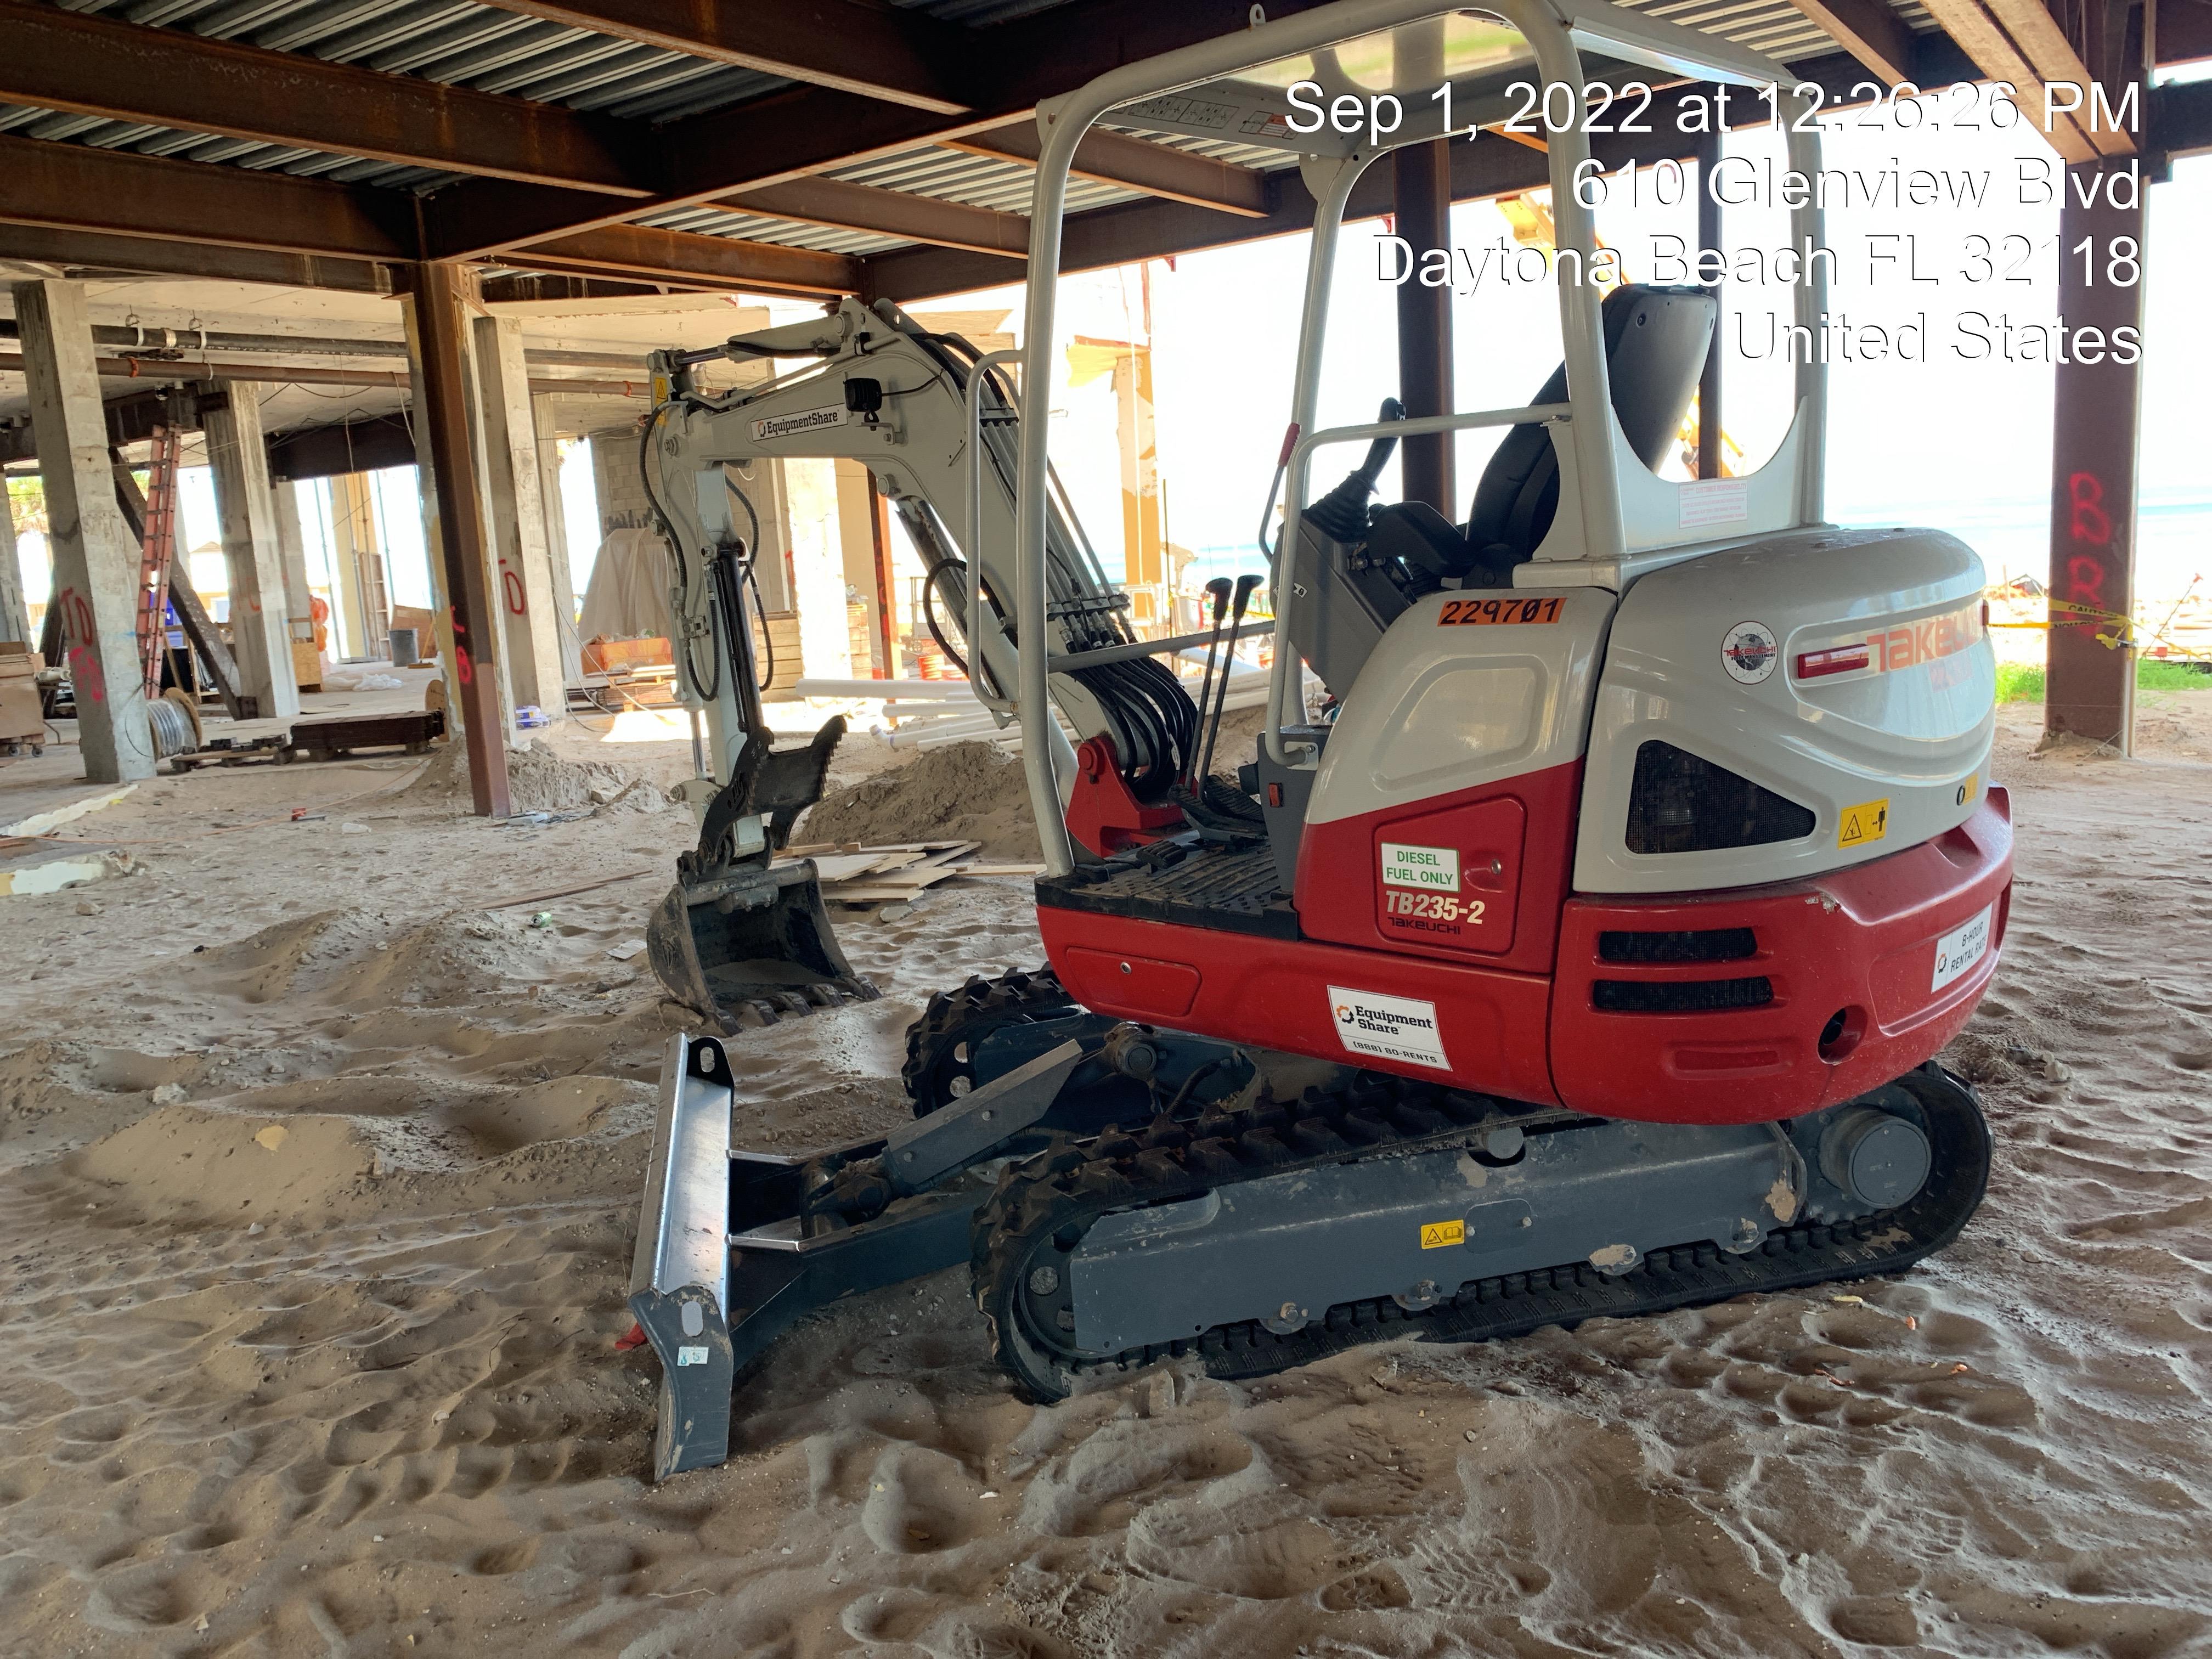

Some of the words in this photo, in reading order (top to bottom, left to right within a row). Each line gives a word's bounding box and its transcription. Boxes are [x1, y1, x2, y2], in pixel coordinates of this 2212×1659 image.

[768, 411, 838, 435] EquipmentShare
[1440, 598, 1559, 625] 229701
[2068, 605, 2118, 618] CAUT
[1397, 851, 1440, 866] DIESEL
[1386, 867, 1417, 882] FUEL
[1420, 871, 1453, 885] ONLY
[1386, 890, 1485, 925] TB235-2
[1962, 921, 1984, 947] 8-HOUR
[1950, 947, 1973, 972] RENTAL
[1975, 934, 1987, 954] RATE
[1355, 1005, 1434, 1029] Equipment
[1358, 1019, 1399, 1035] Share
[1353, 1041, 1382, 1053] (888)
[1385, 1048, 1437, 1063] 80-RENTS
